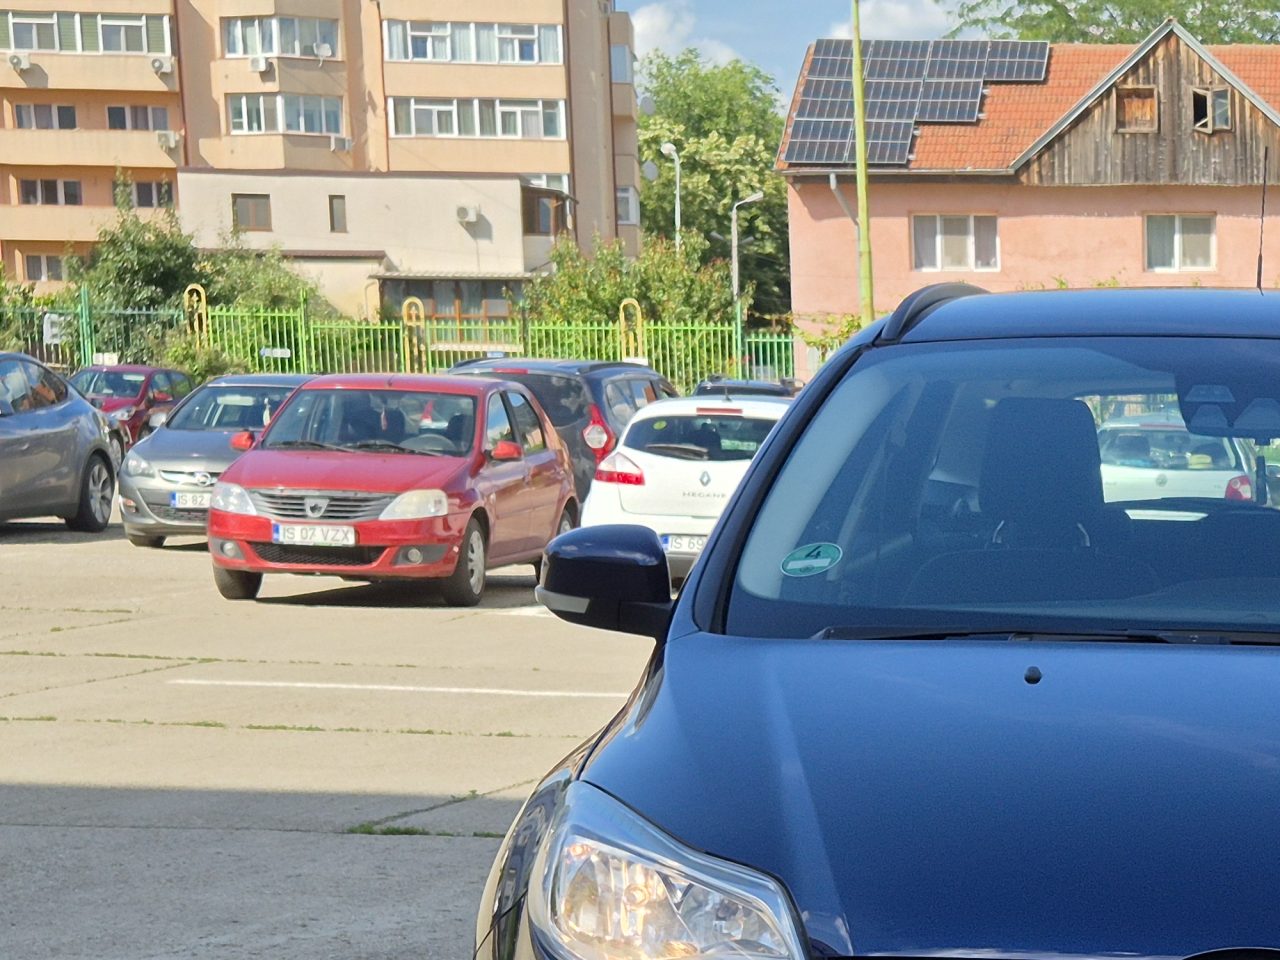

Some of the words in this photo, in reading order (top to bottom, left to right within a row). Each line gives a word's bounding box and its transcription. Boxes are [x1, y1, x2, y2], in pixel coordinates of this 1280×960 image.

[191, 495, 205, 505] 82
[282, 527, 296, 540] IS
[300, 527, 317, 541] 07
[321, 528, 350, 542] VZX
[671, 536, 682, 549] IS
[688, 537, 704, 550] 69
